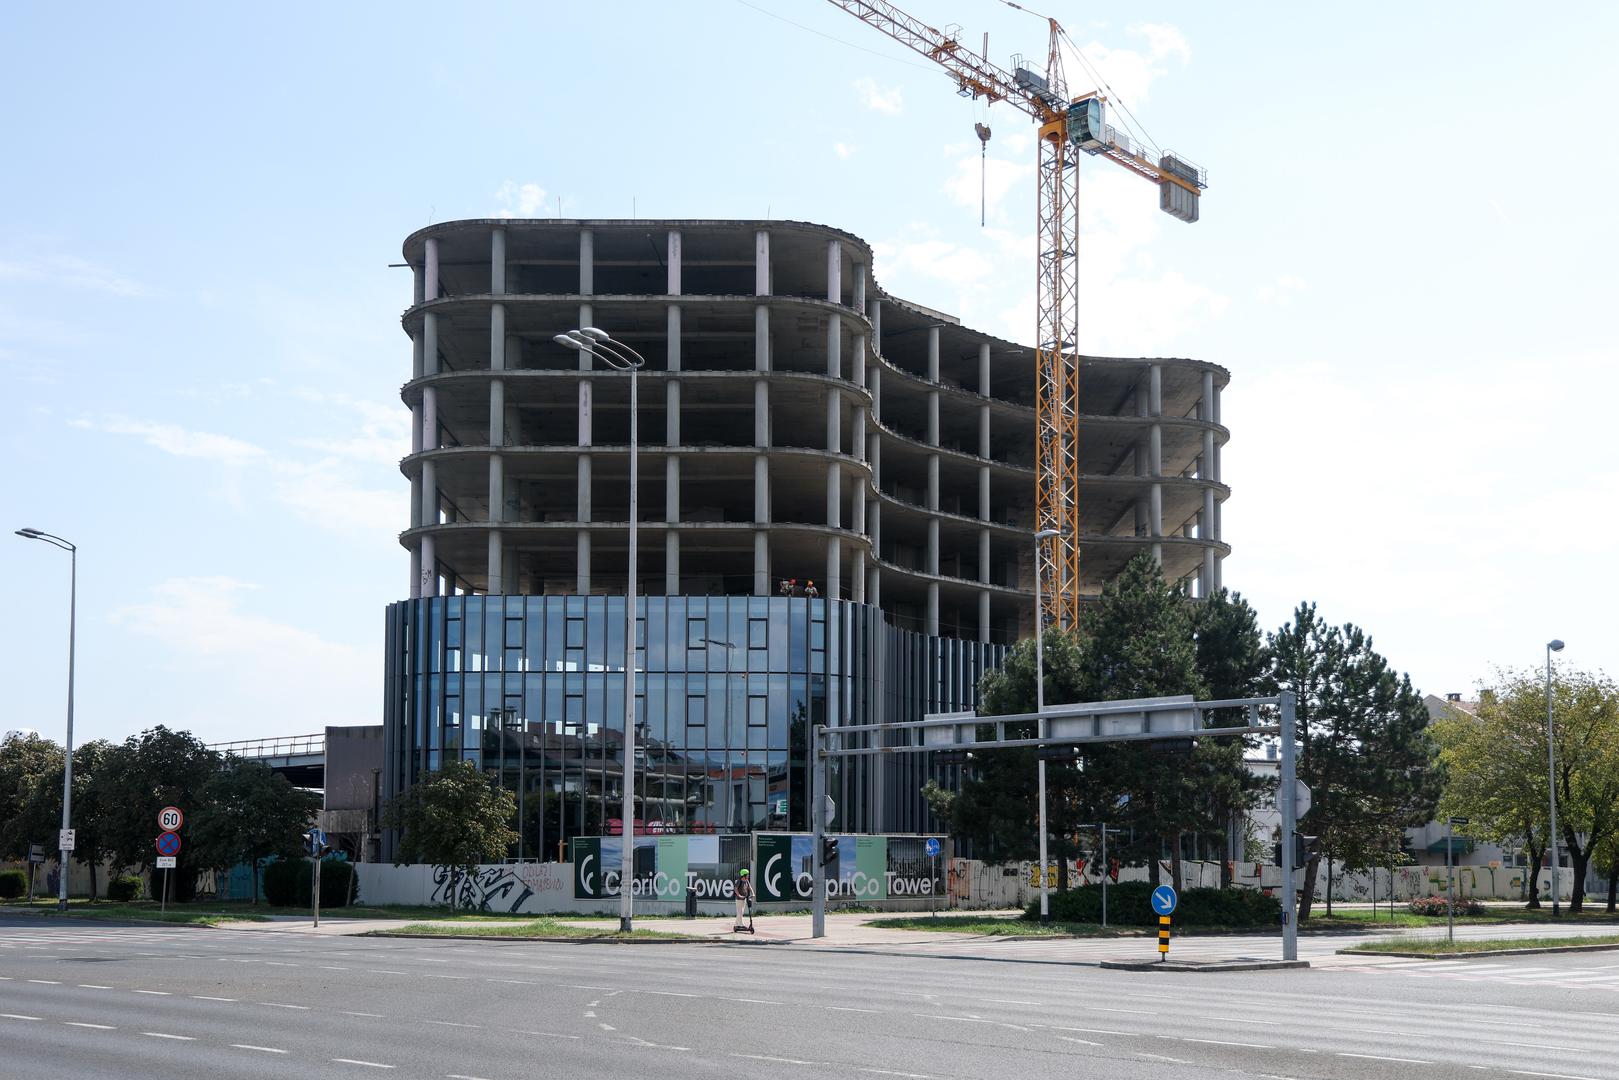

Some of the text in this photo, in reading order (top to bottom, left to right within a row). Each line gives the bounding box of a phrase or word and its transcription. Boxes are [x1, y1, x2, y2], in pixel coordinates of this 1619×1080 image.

[163, 813, 178, 825] 60
[605, 871, 737, 897] CpriCo Towe
[796, 871, 939, 900] CpriCo Tower
